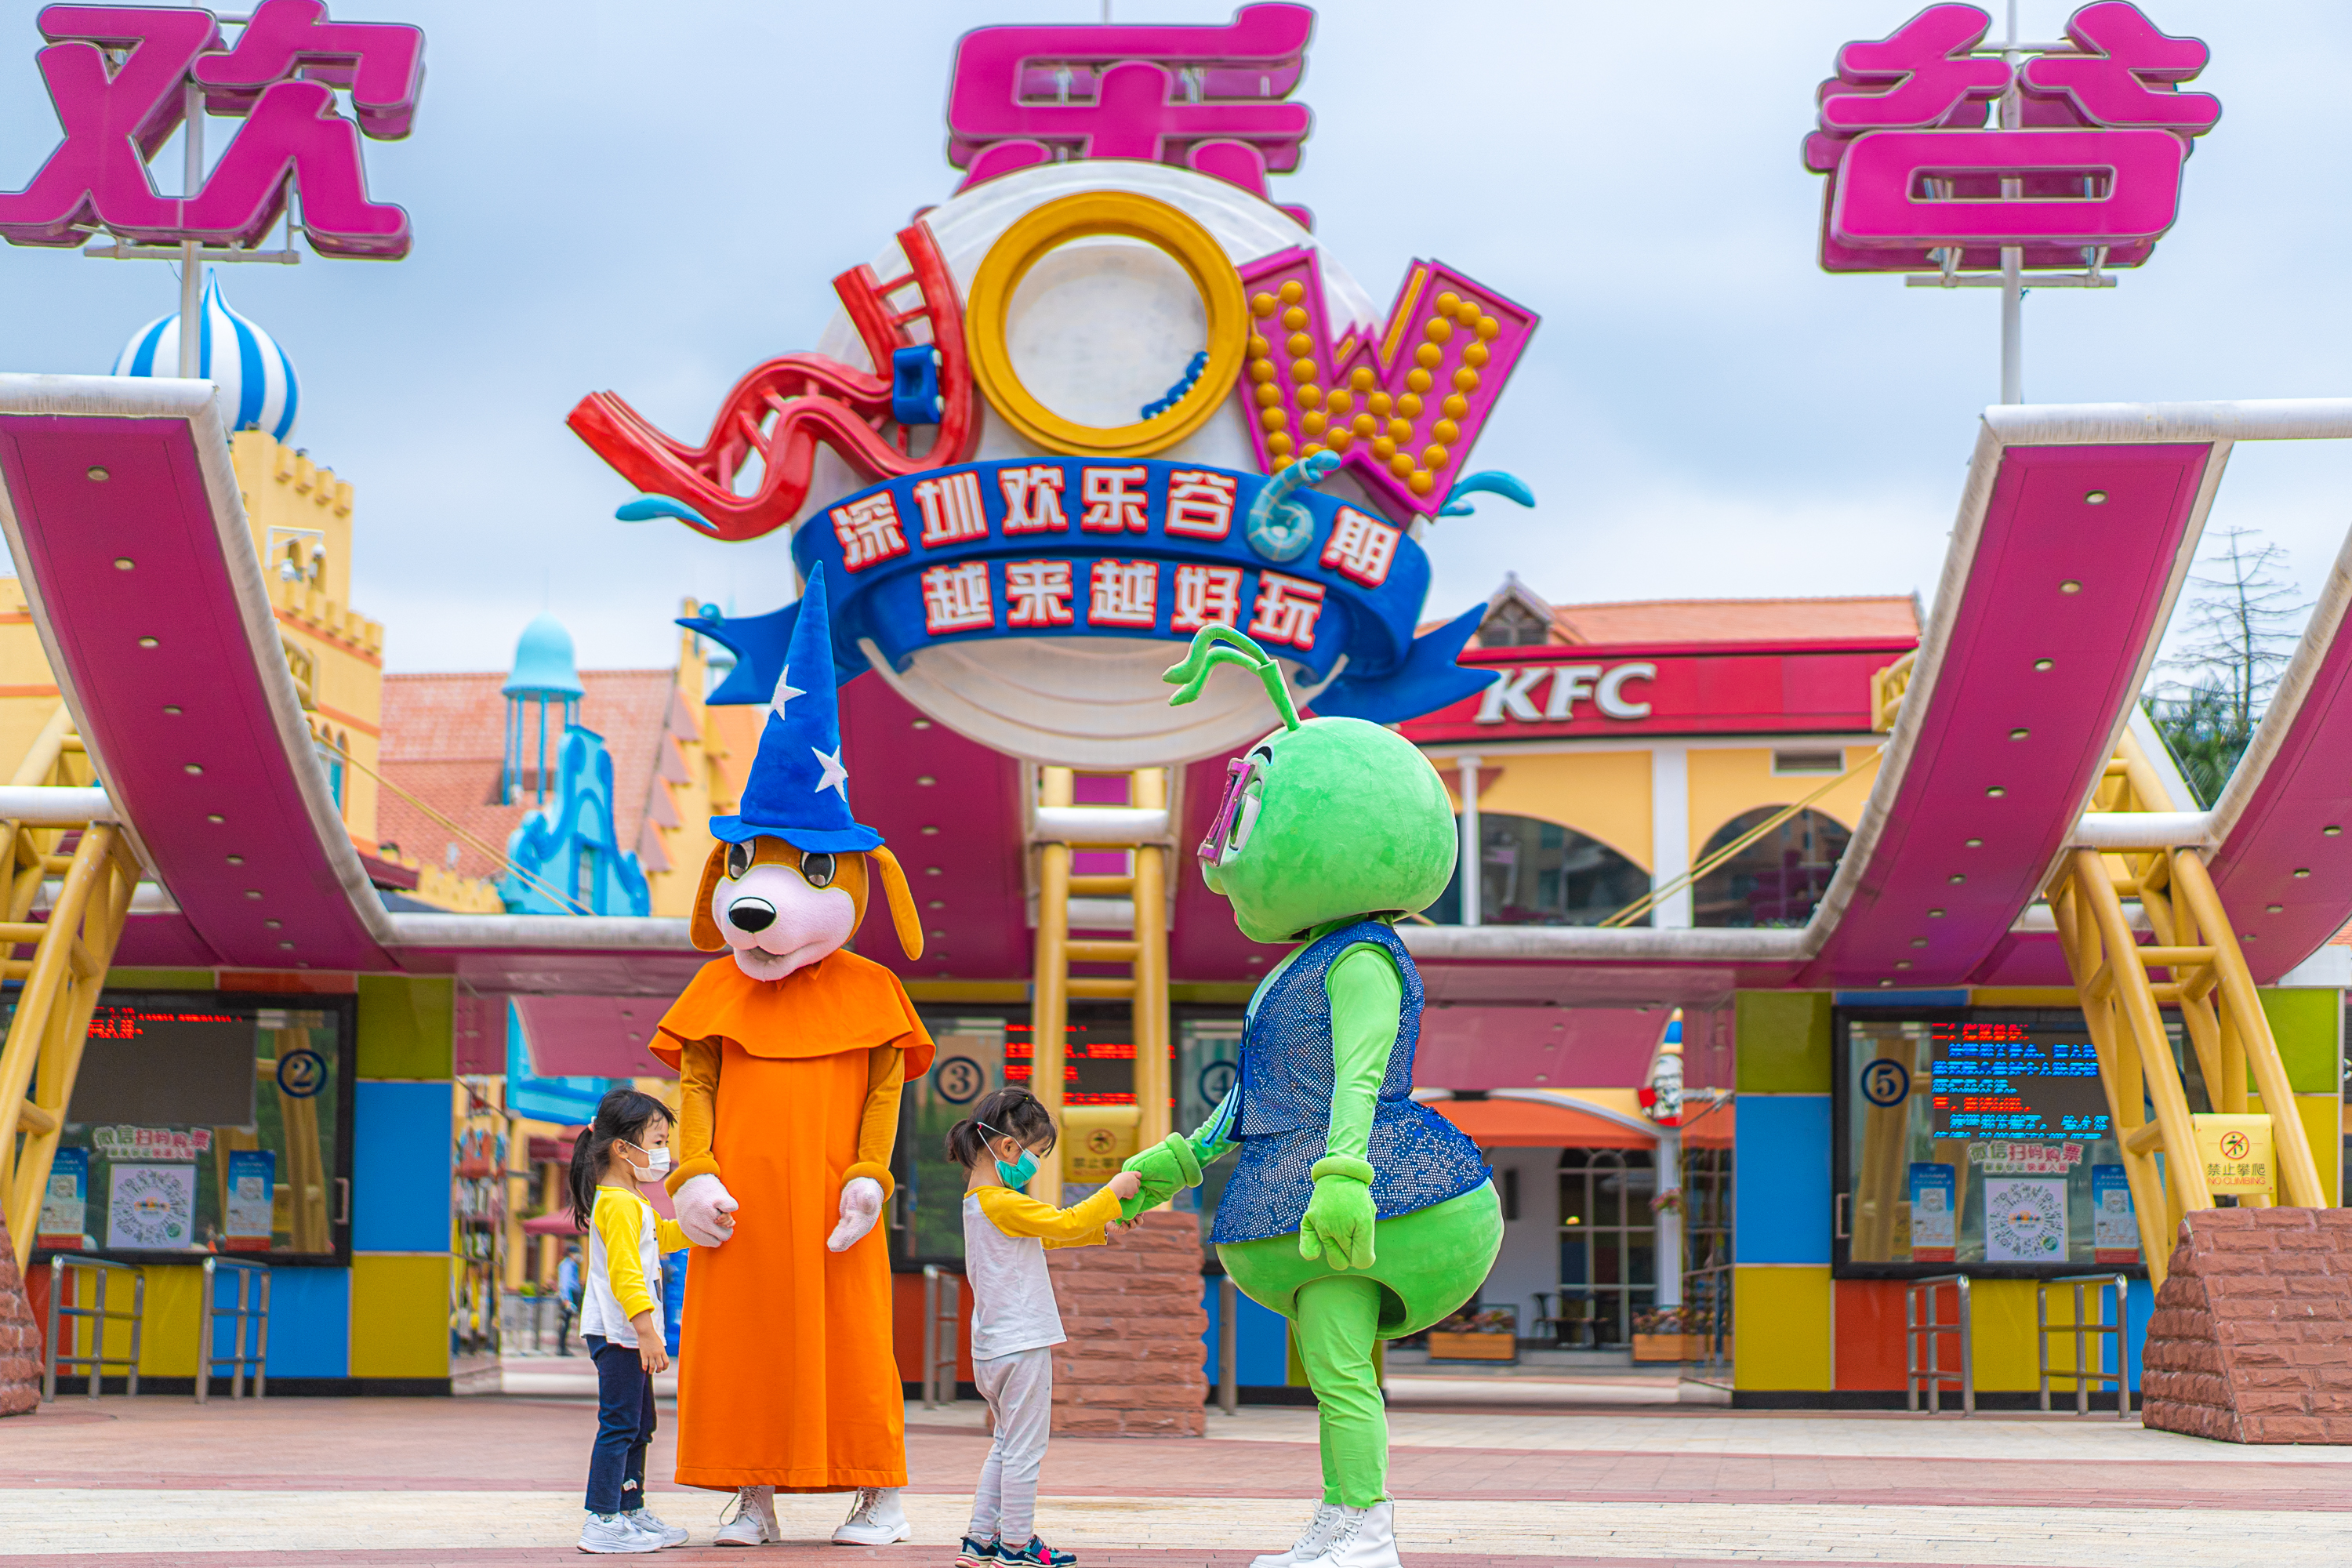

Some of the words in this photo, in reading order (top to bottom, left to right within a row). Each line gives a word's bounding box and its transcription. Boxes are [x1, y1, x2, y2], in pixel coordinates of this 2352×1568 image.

[0, 0, 426, 261] 欢
[914, 2, 1317, 235] 乐
[1802, 0, 2222, 273] 谷
[920, 558, 1327, 652] 越来越好玩
[1475, 662, 1657, 724] KFC
[2207, 1163, 2266, 1176] 禁止攀爬
